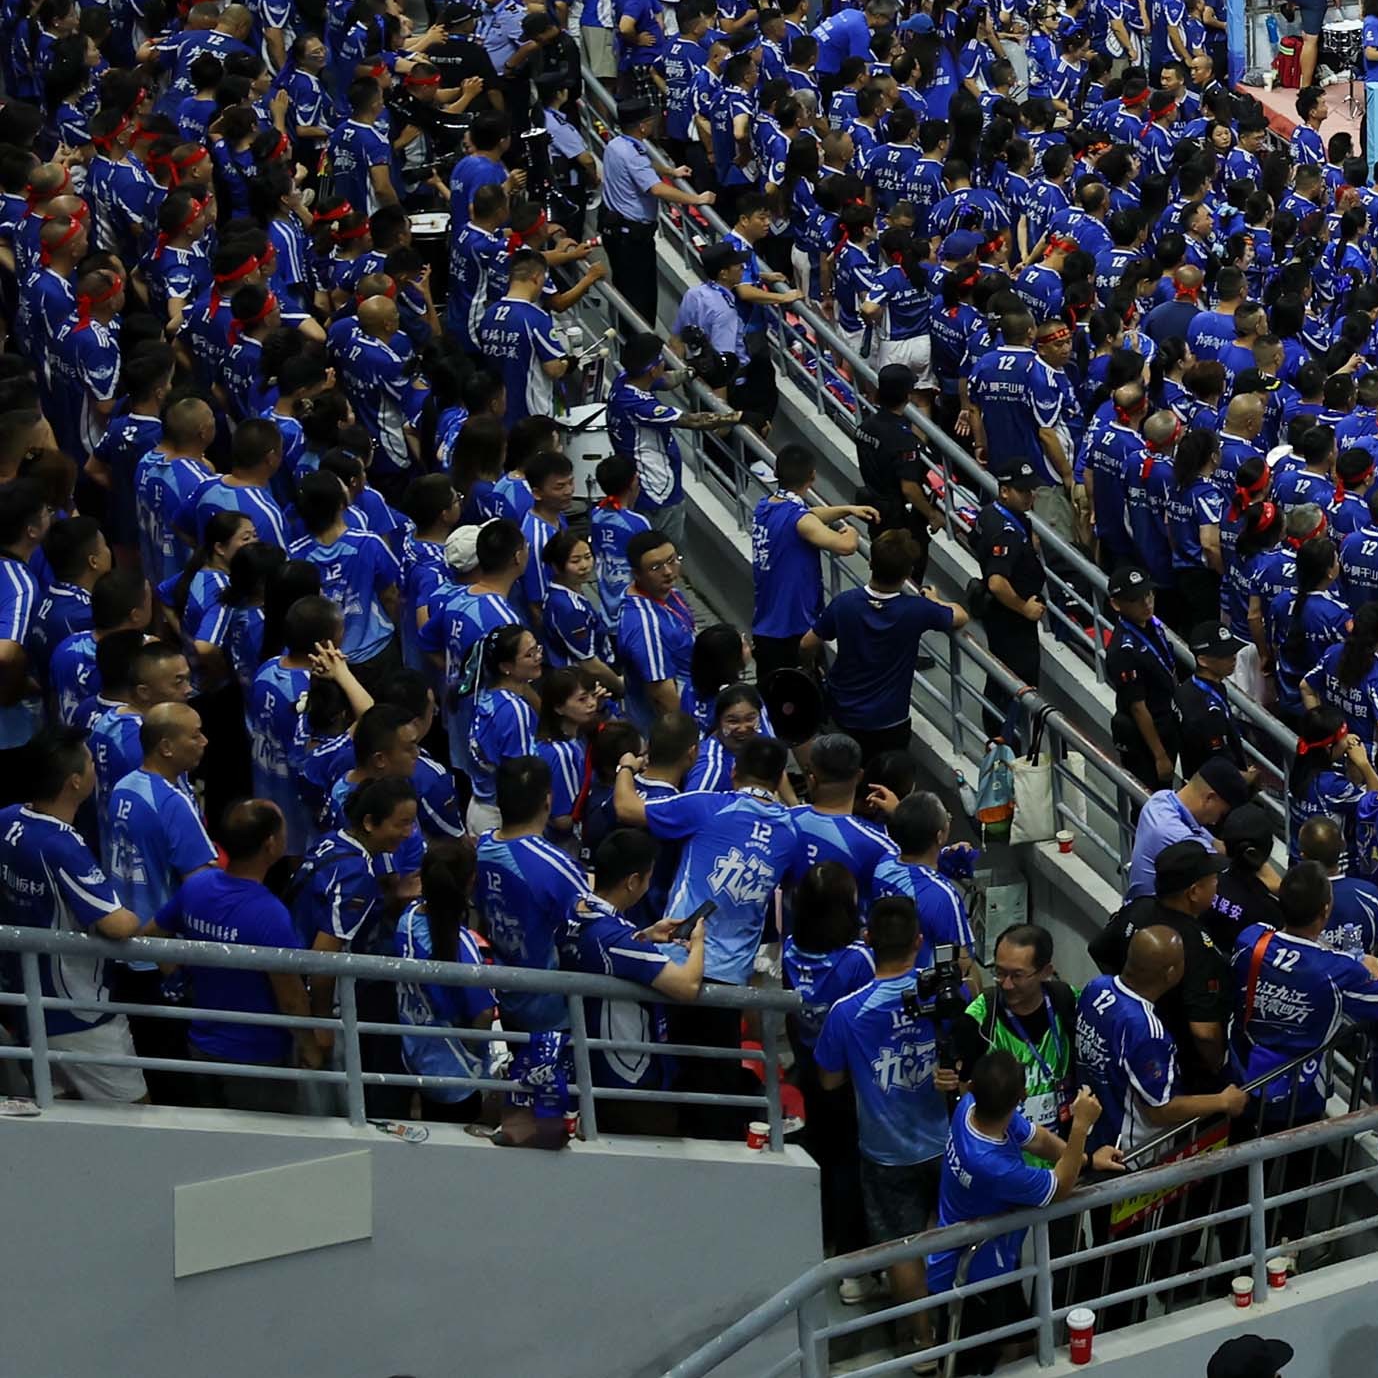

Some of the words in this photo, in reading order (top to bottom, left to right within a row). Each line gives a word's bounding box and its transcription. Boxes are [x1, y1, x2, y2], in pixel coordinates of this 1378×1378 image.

[117, 798, 130, 820] 12
[751, 822, 772, 843] 12
[487, 871, 501, 891] 12
[709, 845, 776, 906] 九江
[1273, 947, 1301, 973] 12
[1092, 990, 1114, 1016] 12
